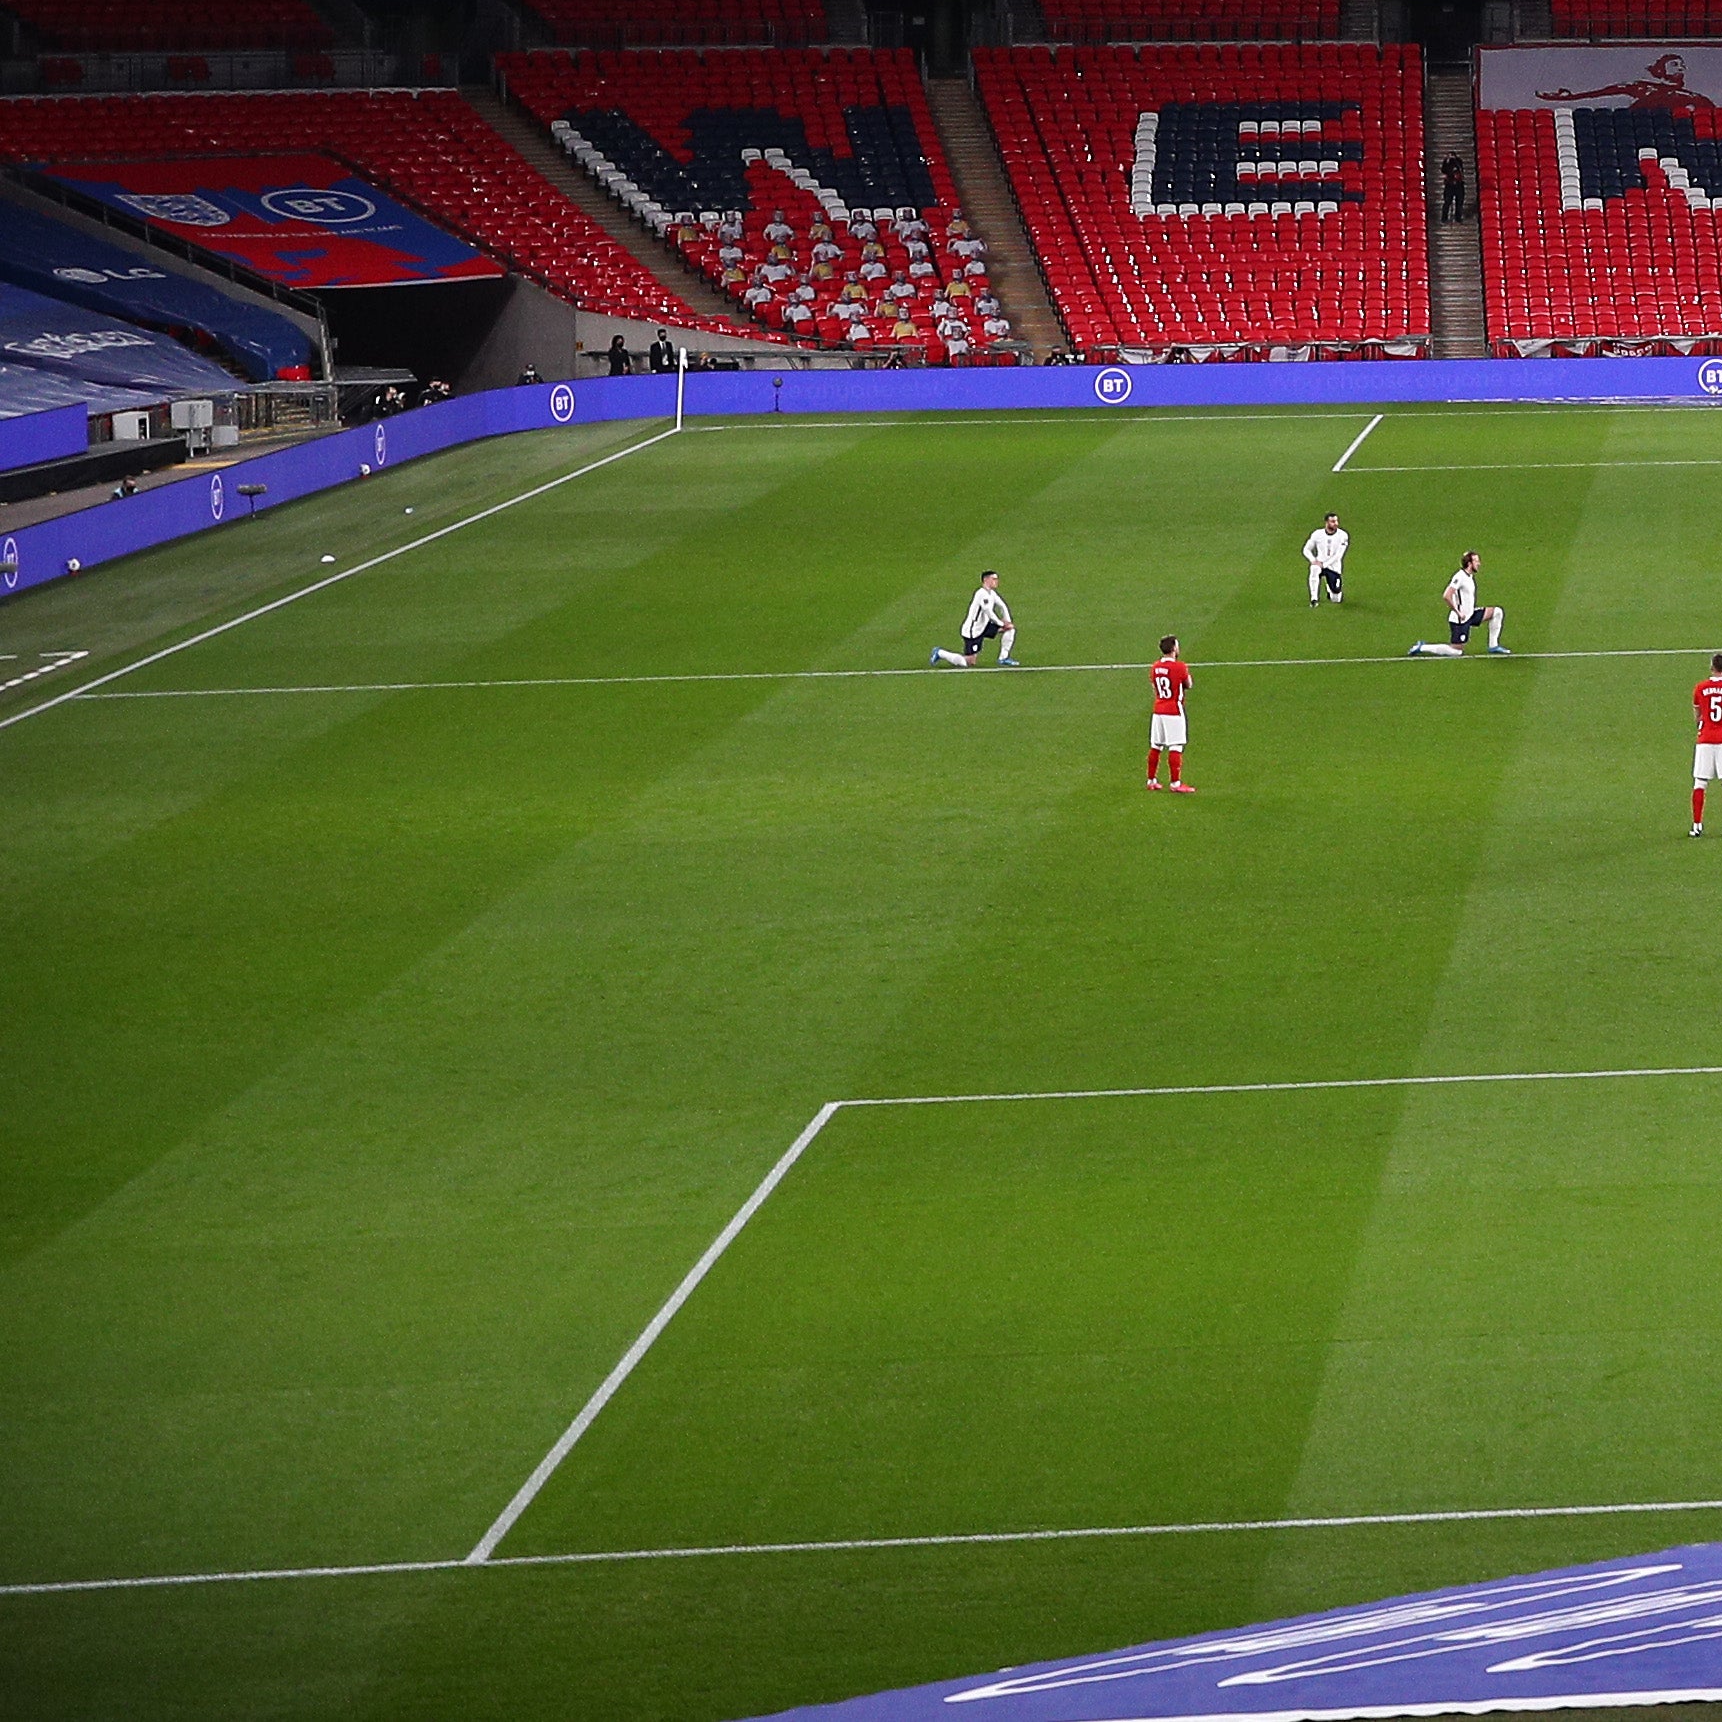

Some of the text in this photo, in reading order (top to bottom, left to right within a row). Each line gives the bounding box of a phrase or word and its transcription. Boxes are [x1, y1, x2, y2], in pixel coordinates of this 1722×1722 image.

[284, 197, 347, 214] BT
[1103, 378, 1124, 393] BT
[555, 396, 569, 411] BT
[1156, 676, 1171, 698] 13
[1710, 696, 1722, 721] 5
